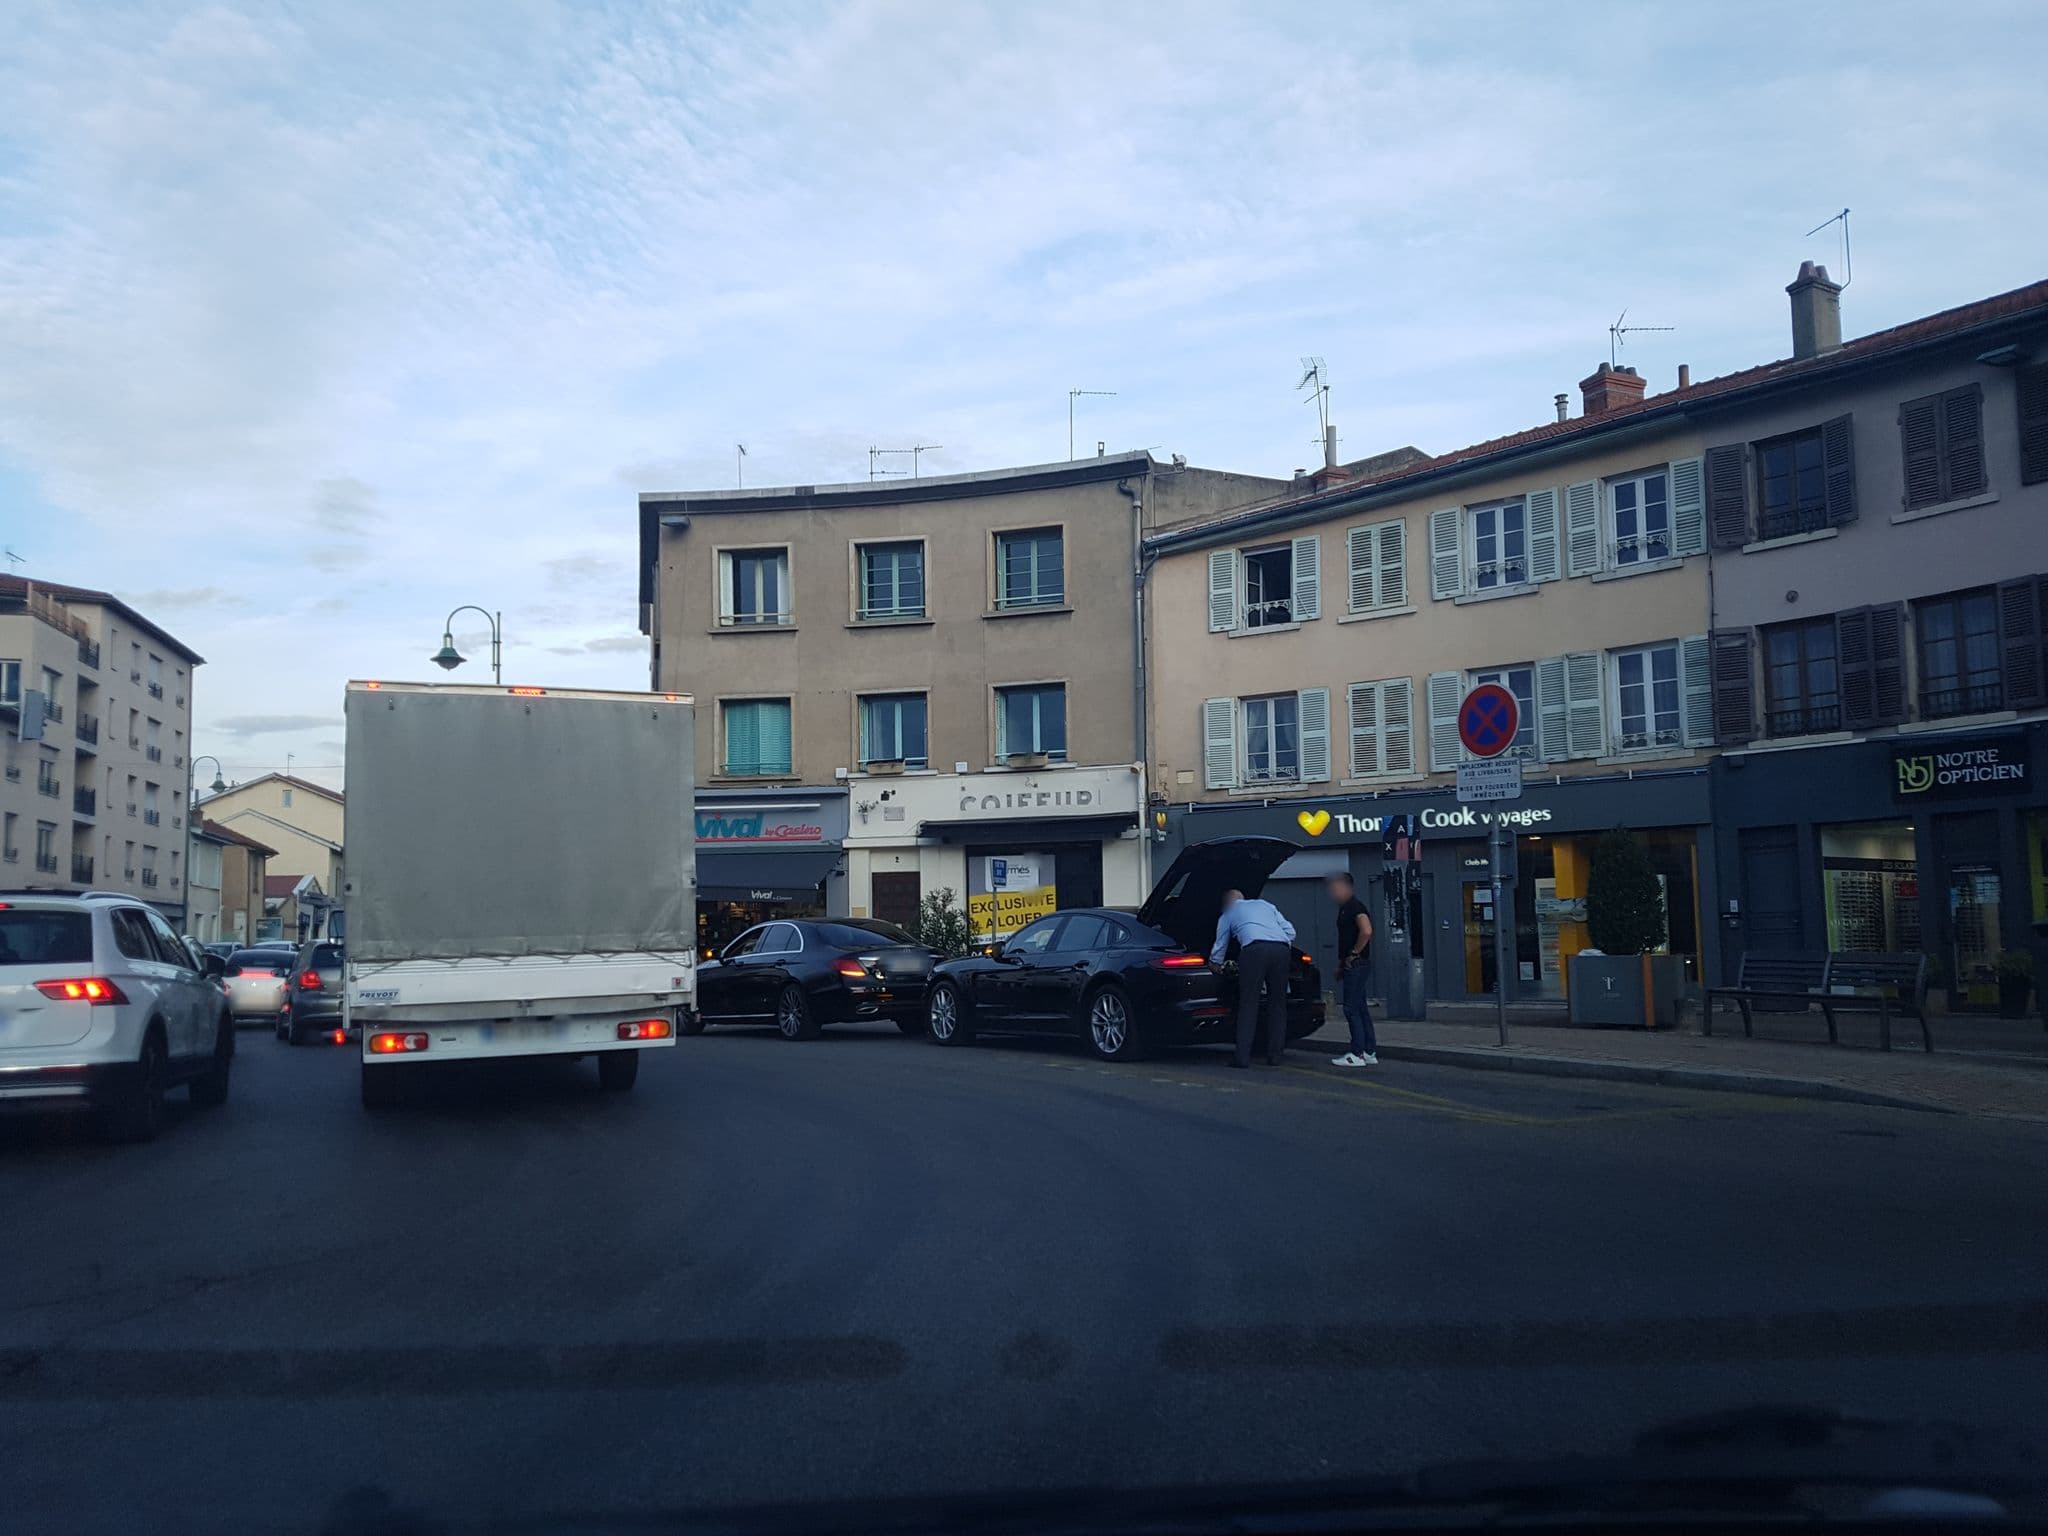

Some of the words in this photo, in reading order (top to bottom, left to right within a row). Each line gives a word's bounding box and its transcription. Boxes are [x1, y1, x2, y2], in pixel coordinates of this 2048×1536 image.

[1937, 749, 1999, 768] NOTRE
[1938, 764, 2025, 785] OPTICIEN
[1421, 806, 1477, 828] Cook
[775, 824, 822, 837] Casino
